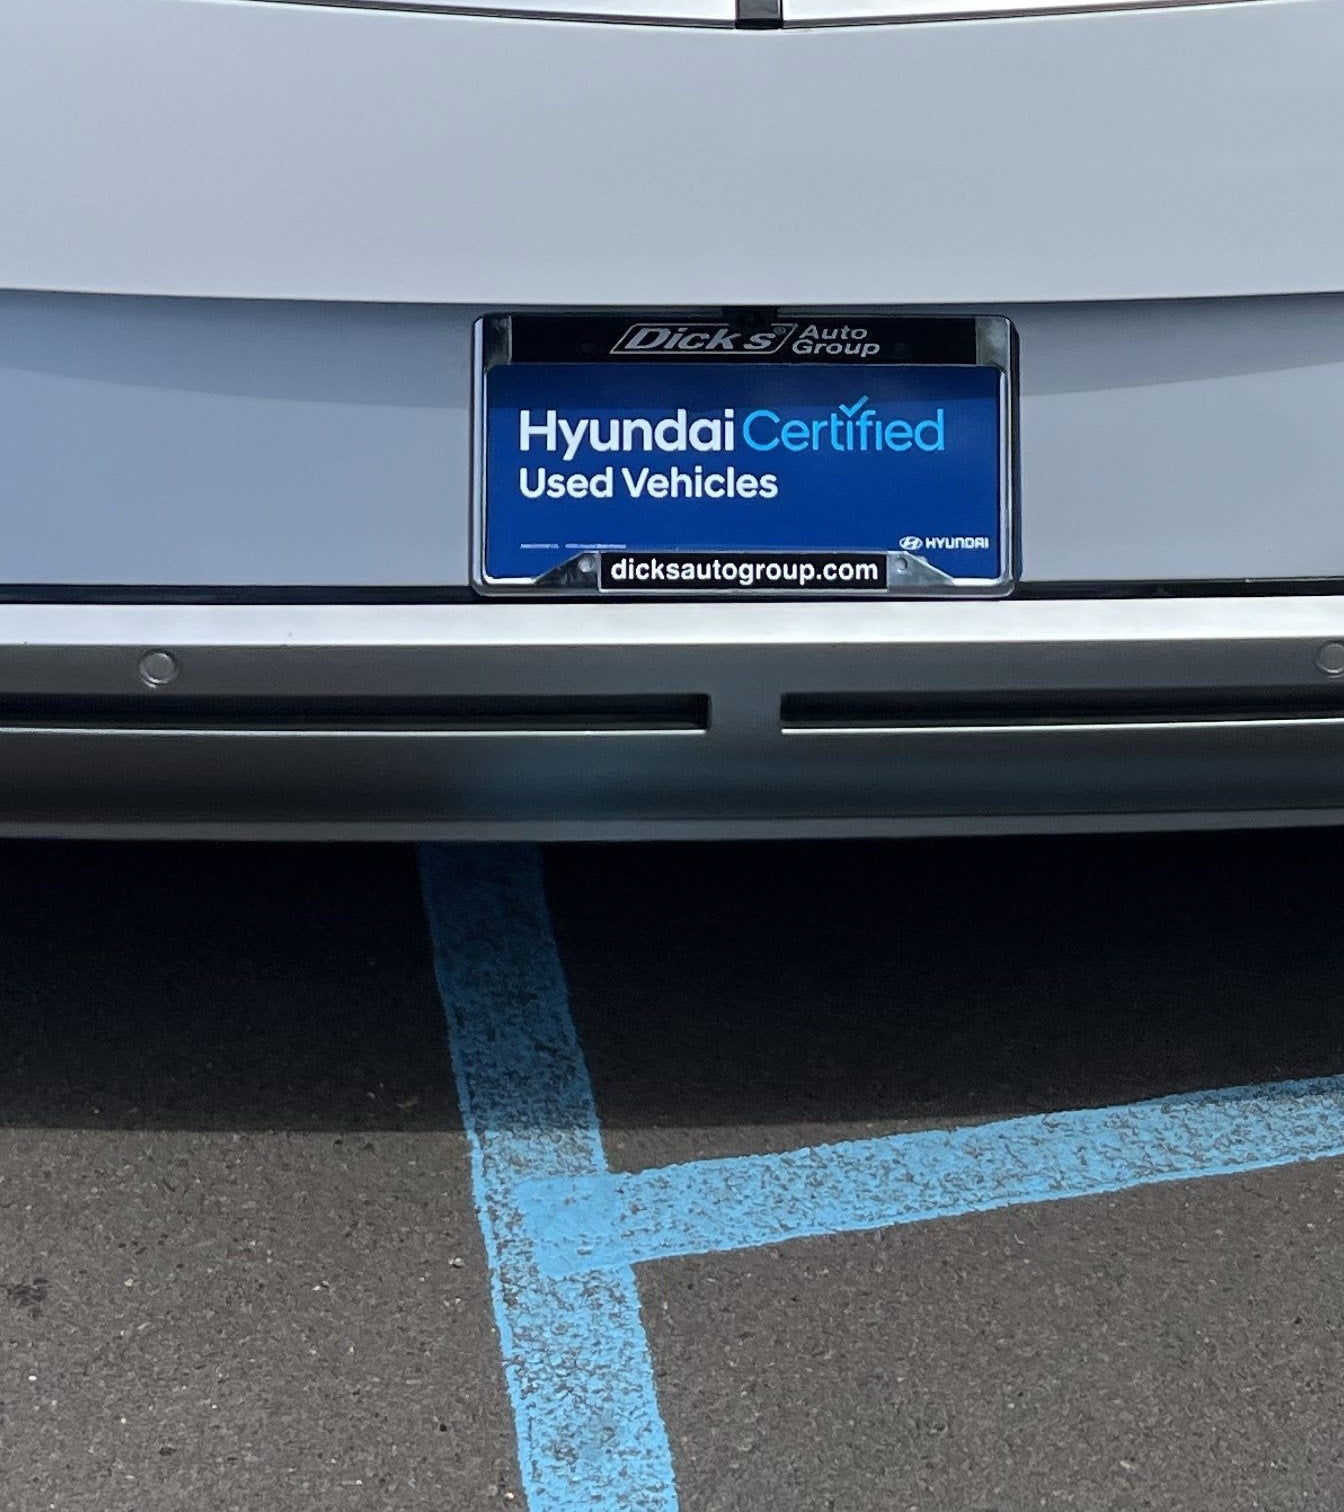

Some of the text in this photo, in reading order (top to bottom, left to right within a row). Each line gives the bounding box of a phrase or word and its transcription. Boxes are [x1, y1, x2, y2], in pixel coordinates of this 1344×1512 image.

[624, 326, 777, 350] Dicks
[799, 324, 868, 340] Auto
[792, 340, 880, 357] Group
[519, 395, 946, 460] Hyundai Certified
[519, 465, 779, 499] Used Vehicles
[925, 536, 990, 549] HYUNDAI
[610, 557, 879, 586] dicksautogroup.com
